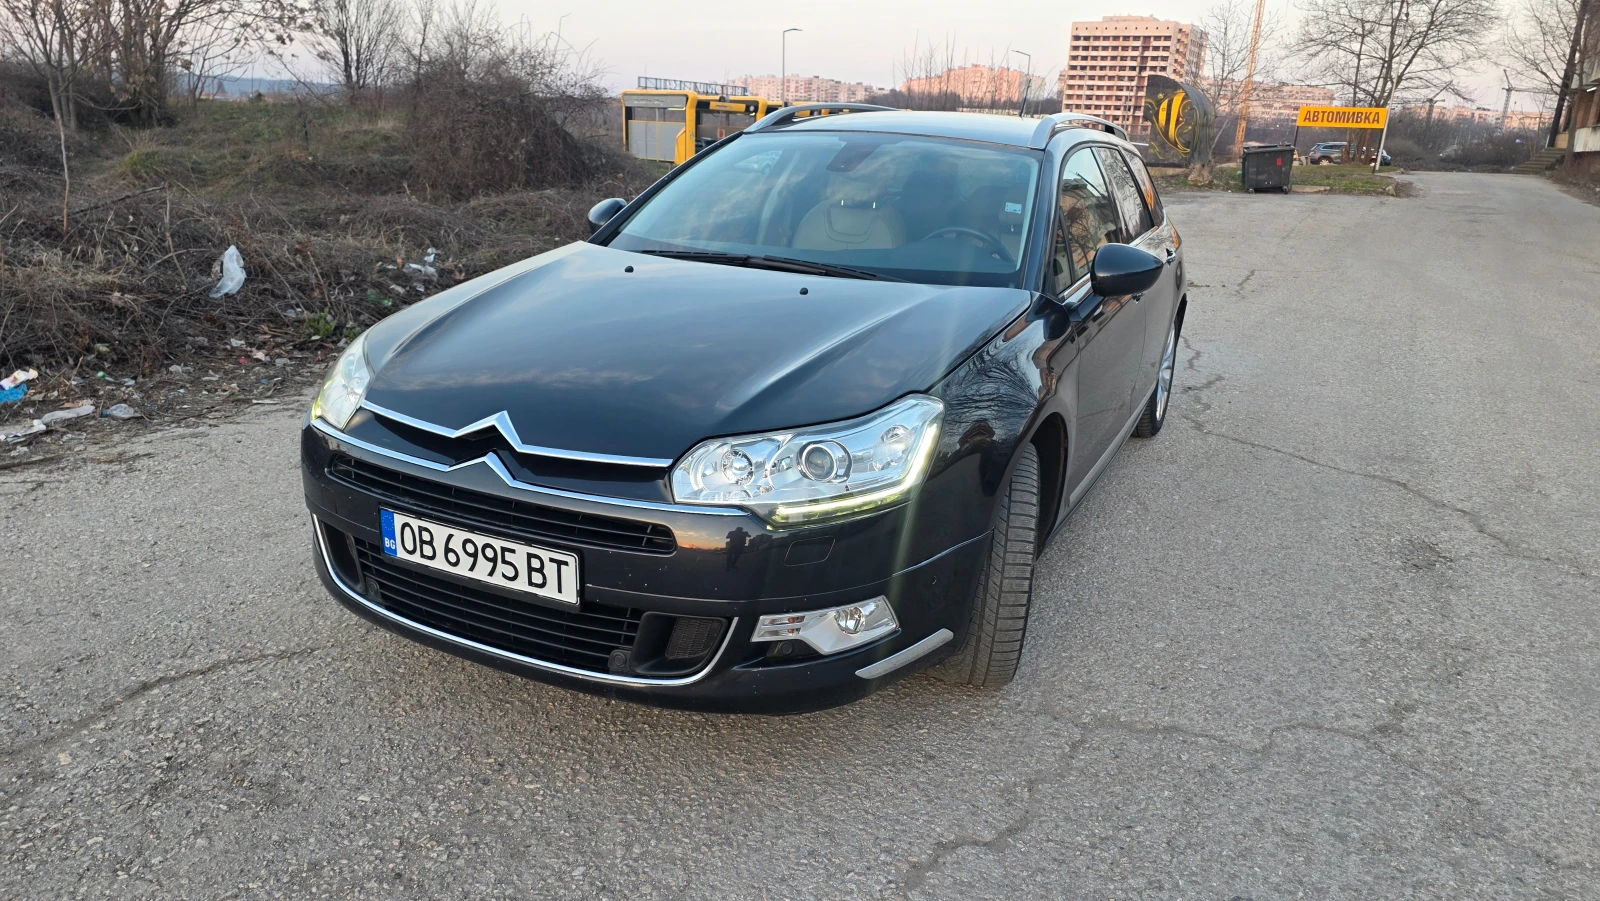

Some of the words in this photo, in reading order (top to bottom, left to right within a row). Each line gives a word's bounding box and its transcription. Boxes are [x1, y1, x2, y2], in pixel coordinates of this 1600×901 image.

[1303, 110, 1380, 124] АВТОМИВКА
[384, 537, 396, 550] BG
[400, 522, 437, 561] OB
[443, 533, 519, 582] 6995
[526, 552, 569, 594] BT
